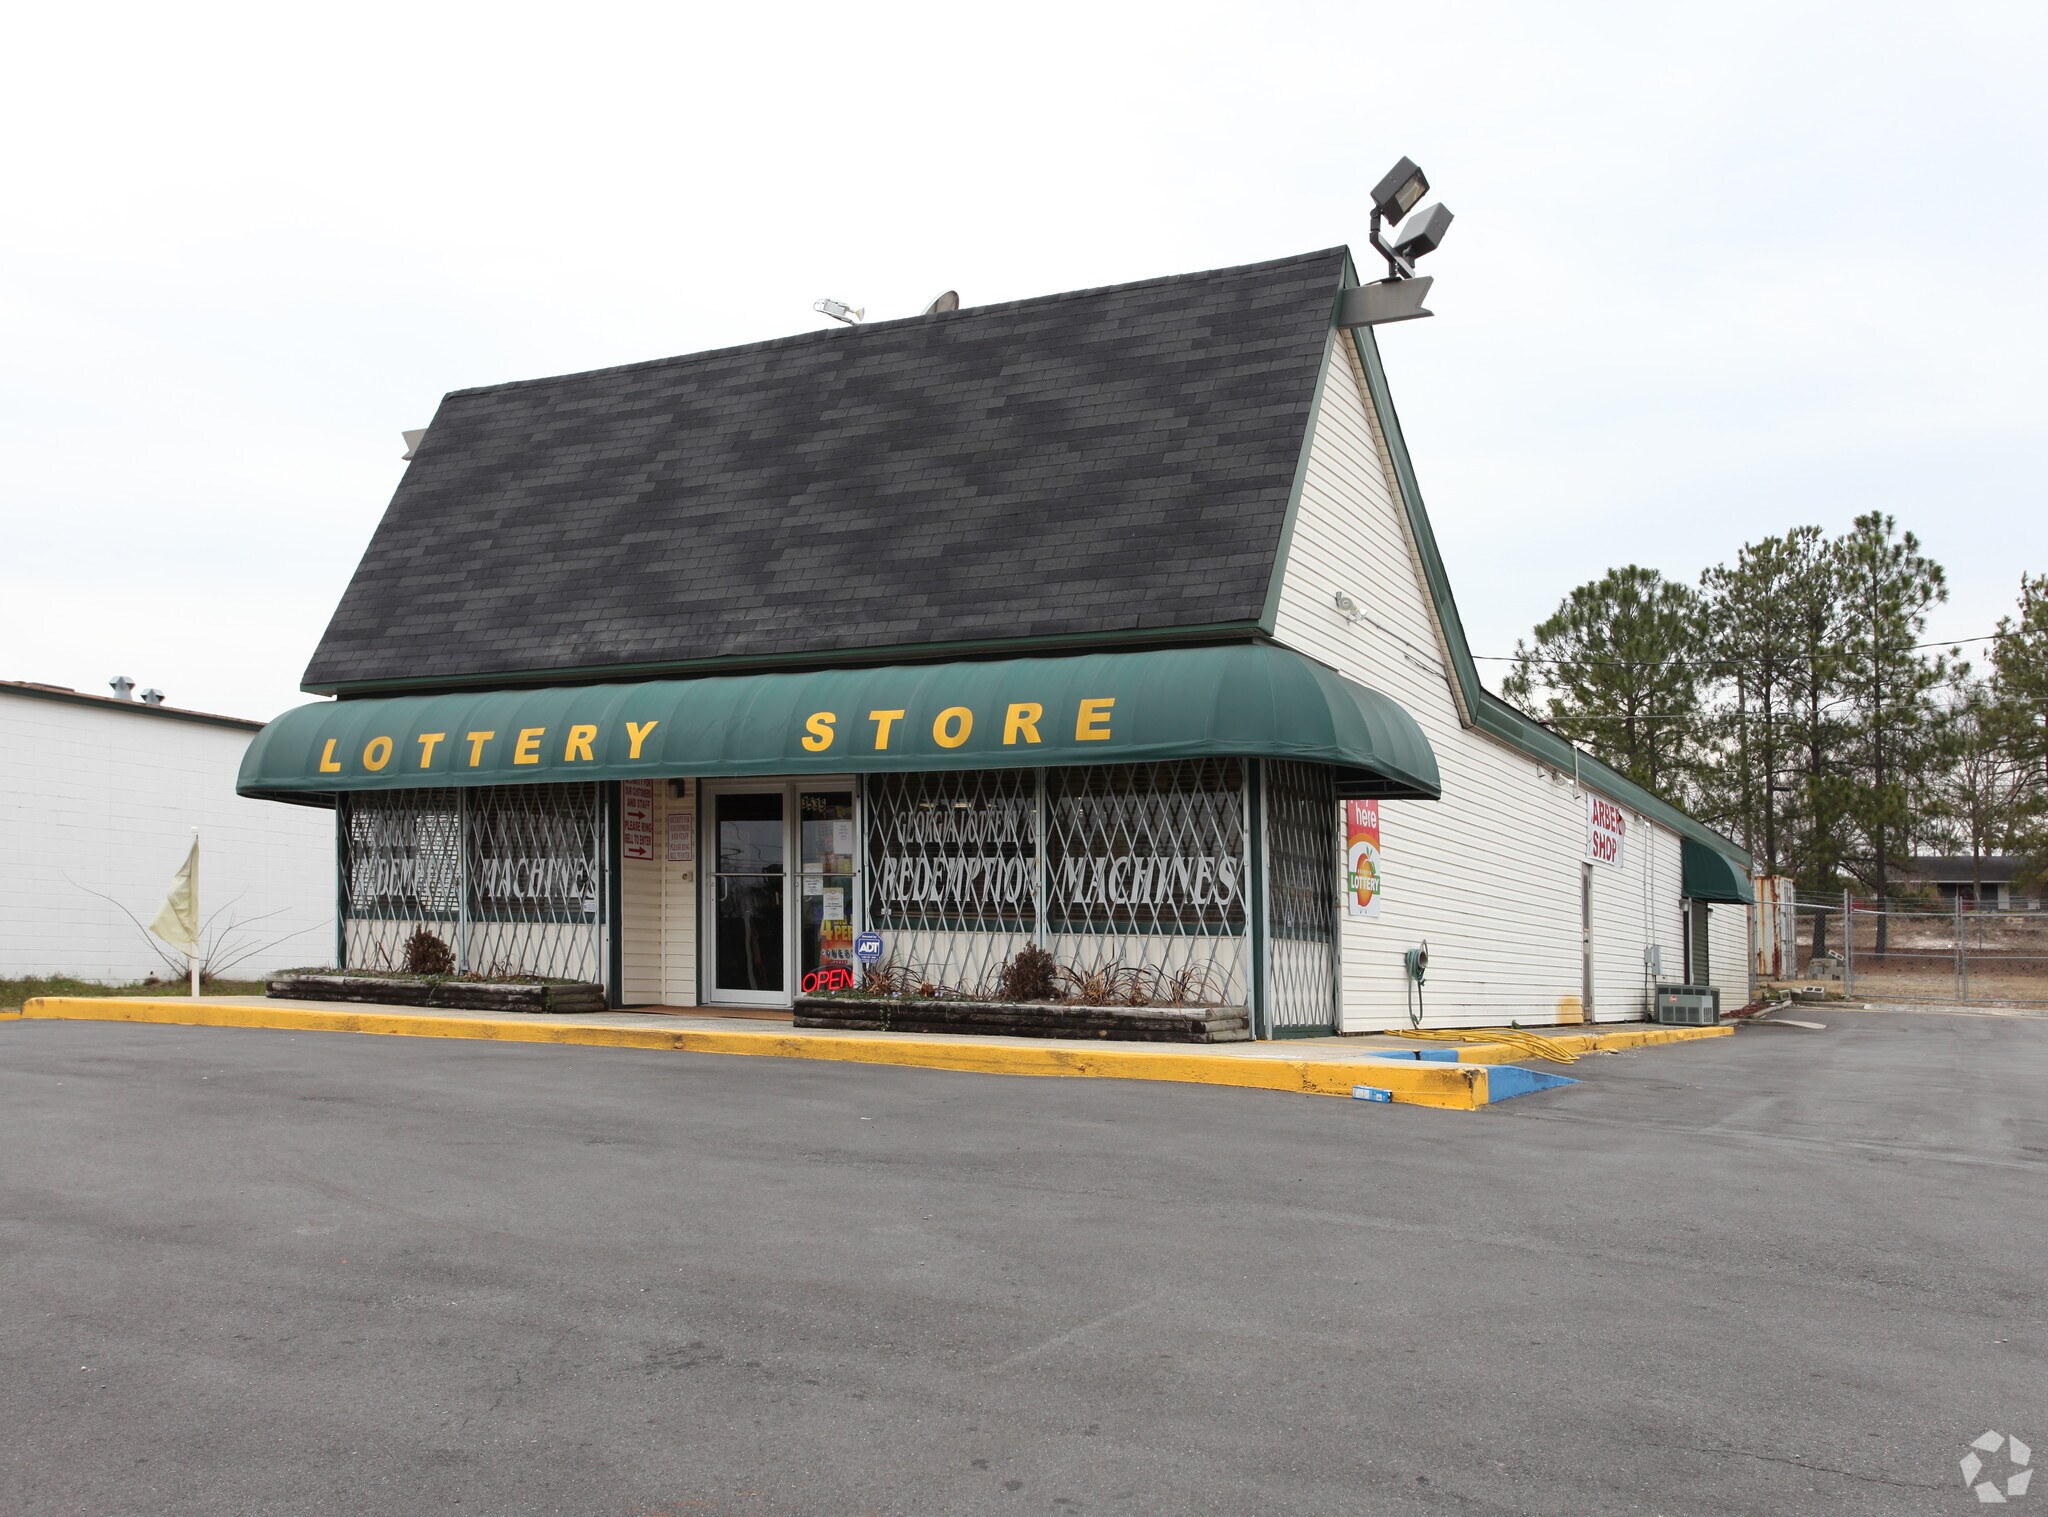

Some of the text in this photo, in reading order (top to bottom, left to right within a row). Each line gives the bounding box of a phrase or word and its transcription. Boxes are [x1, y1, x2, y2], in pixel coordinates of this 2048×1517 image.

[319, 698, 1116, 773] LOTTERY STORE
[627, 798, 650, 809] AND STAFF
[1356, 802, 1377, 828] here
[624, 820, 652, 833] PLEASE RING
[624, 833, 652, 846] BELL TO ENTER
[1593, 830, 1617, 862] SHOP
[880, 856, 1238, 905] REDEMPTION MACHINES
[1350, 875, 1380, 892] LOTTERY
[859, 941, 880, 953] ADT
[802, 969, 854, 992] OPEN
